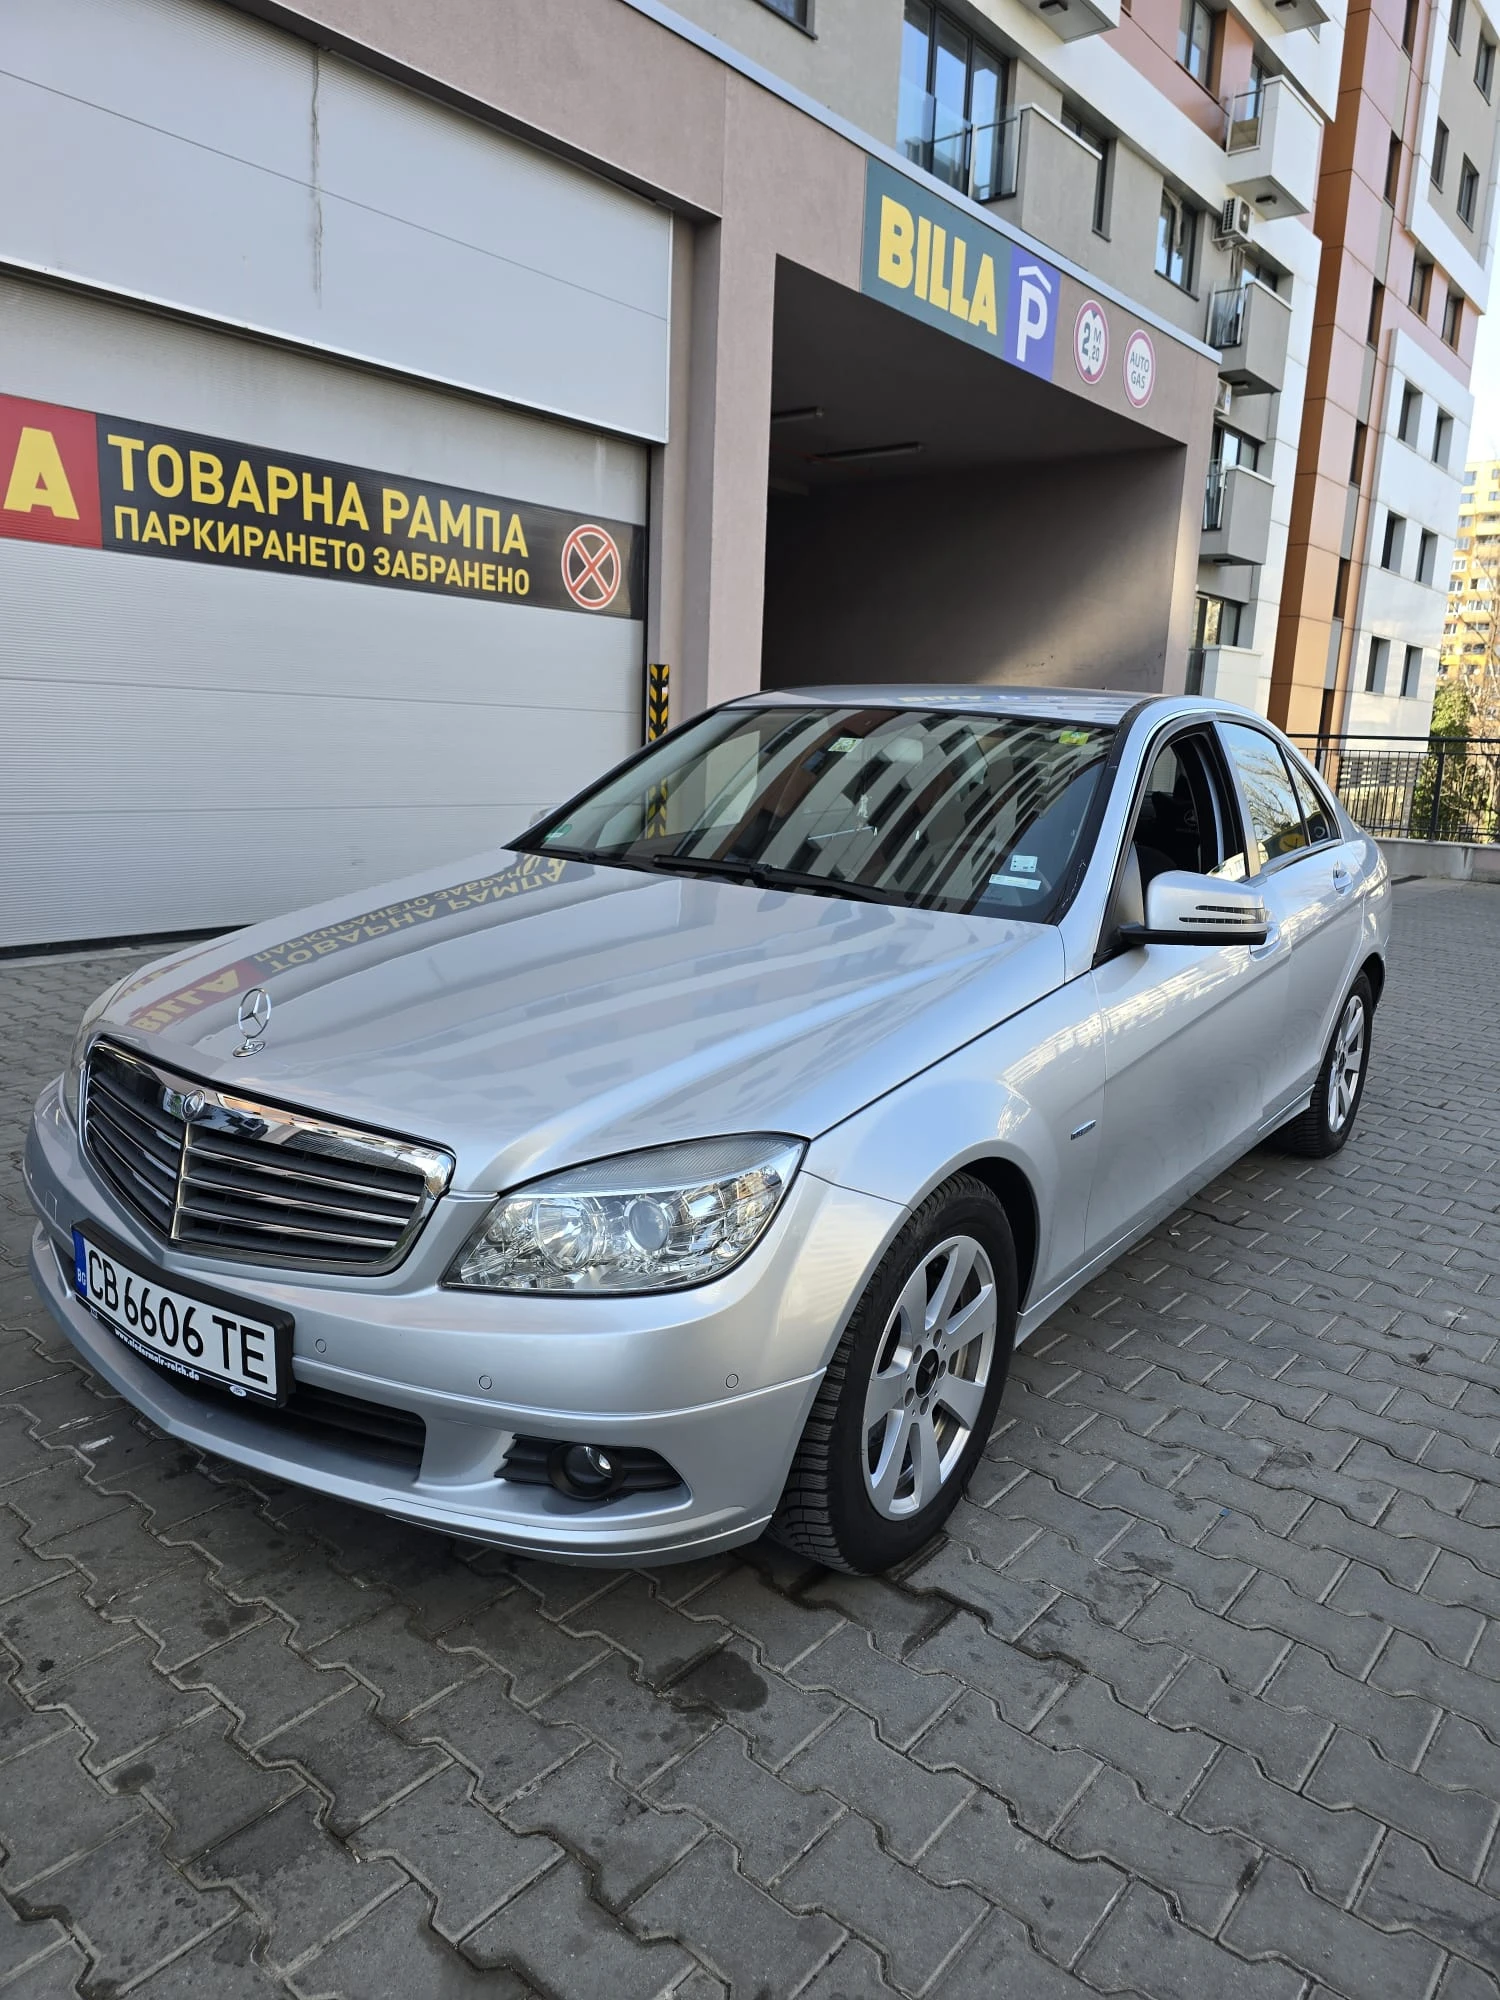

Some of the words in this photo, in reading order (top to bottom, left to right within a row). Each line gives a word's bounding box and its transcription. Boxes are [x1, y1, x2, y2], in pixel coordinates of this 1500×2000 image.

[878, 195, 998, 336] BILLA
[1016, 280, 1048, 362] P
[1129, 351, 1150, 373] AUTO
[1130, 371, 1146, 389] GAS
[107, 434, 370, 531] ТОВАРНА
[382, 488, 529, 558] РАМПА
[114, 505, 366, 573] ПАРКИРАНЕТО
[373, 546, 531, 597] ЗАБРАНЕНО
[77, 1267, 87, 1286] BG
[89, 1249, 119, 1312] CB
[124, 1276, 204, 1358] 6606
[211, 1314, 268, 1385] TE
